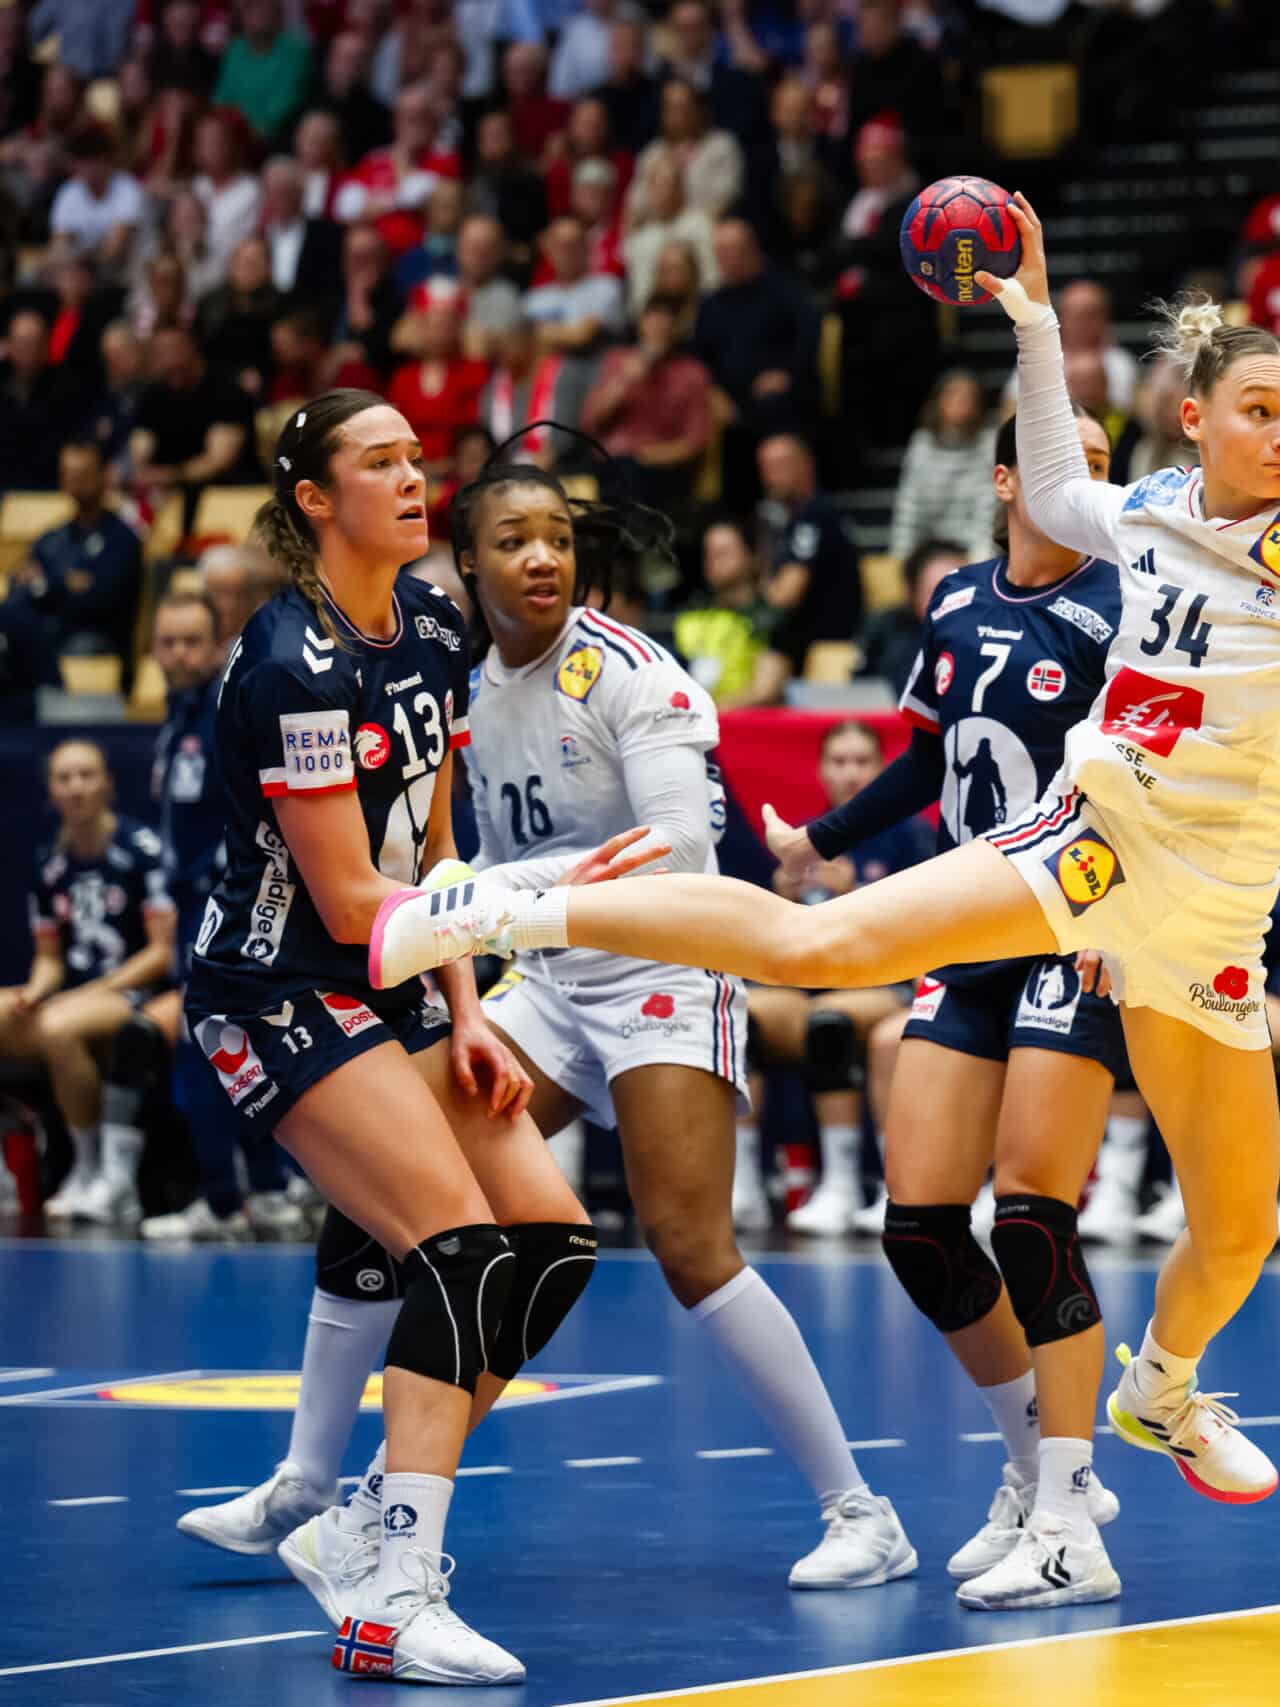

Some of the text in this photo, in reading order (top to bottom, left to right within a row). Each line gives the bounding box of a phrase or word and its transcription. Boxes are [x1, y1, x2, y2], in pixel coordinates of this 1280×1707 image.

[953, 238, 974, 302] molten
[1140, 583, 1213, 668] 34
[971, 642, 1011, 713] 7
[285, 730, 350, 752] REMA
[293, 752, 344, 774] 1000
[393, 691, 445, 780] 13
[501, 774, 554, 846] 26
[281, 1026, 314, 1054] 13
